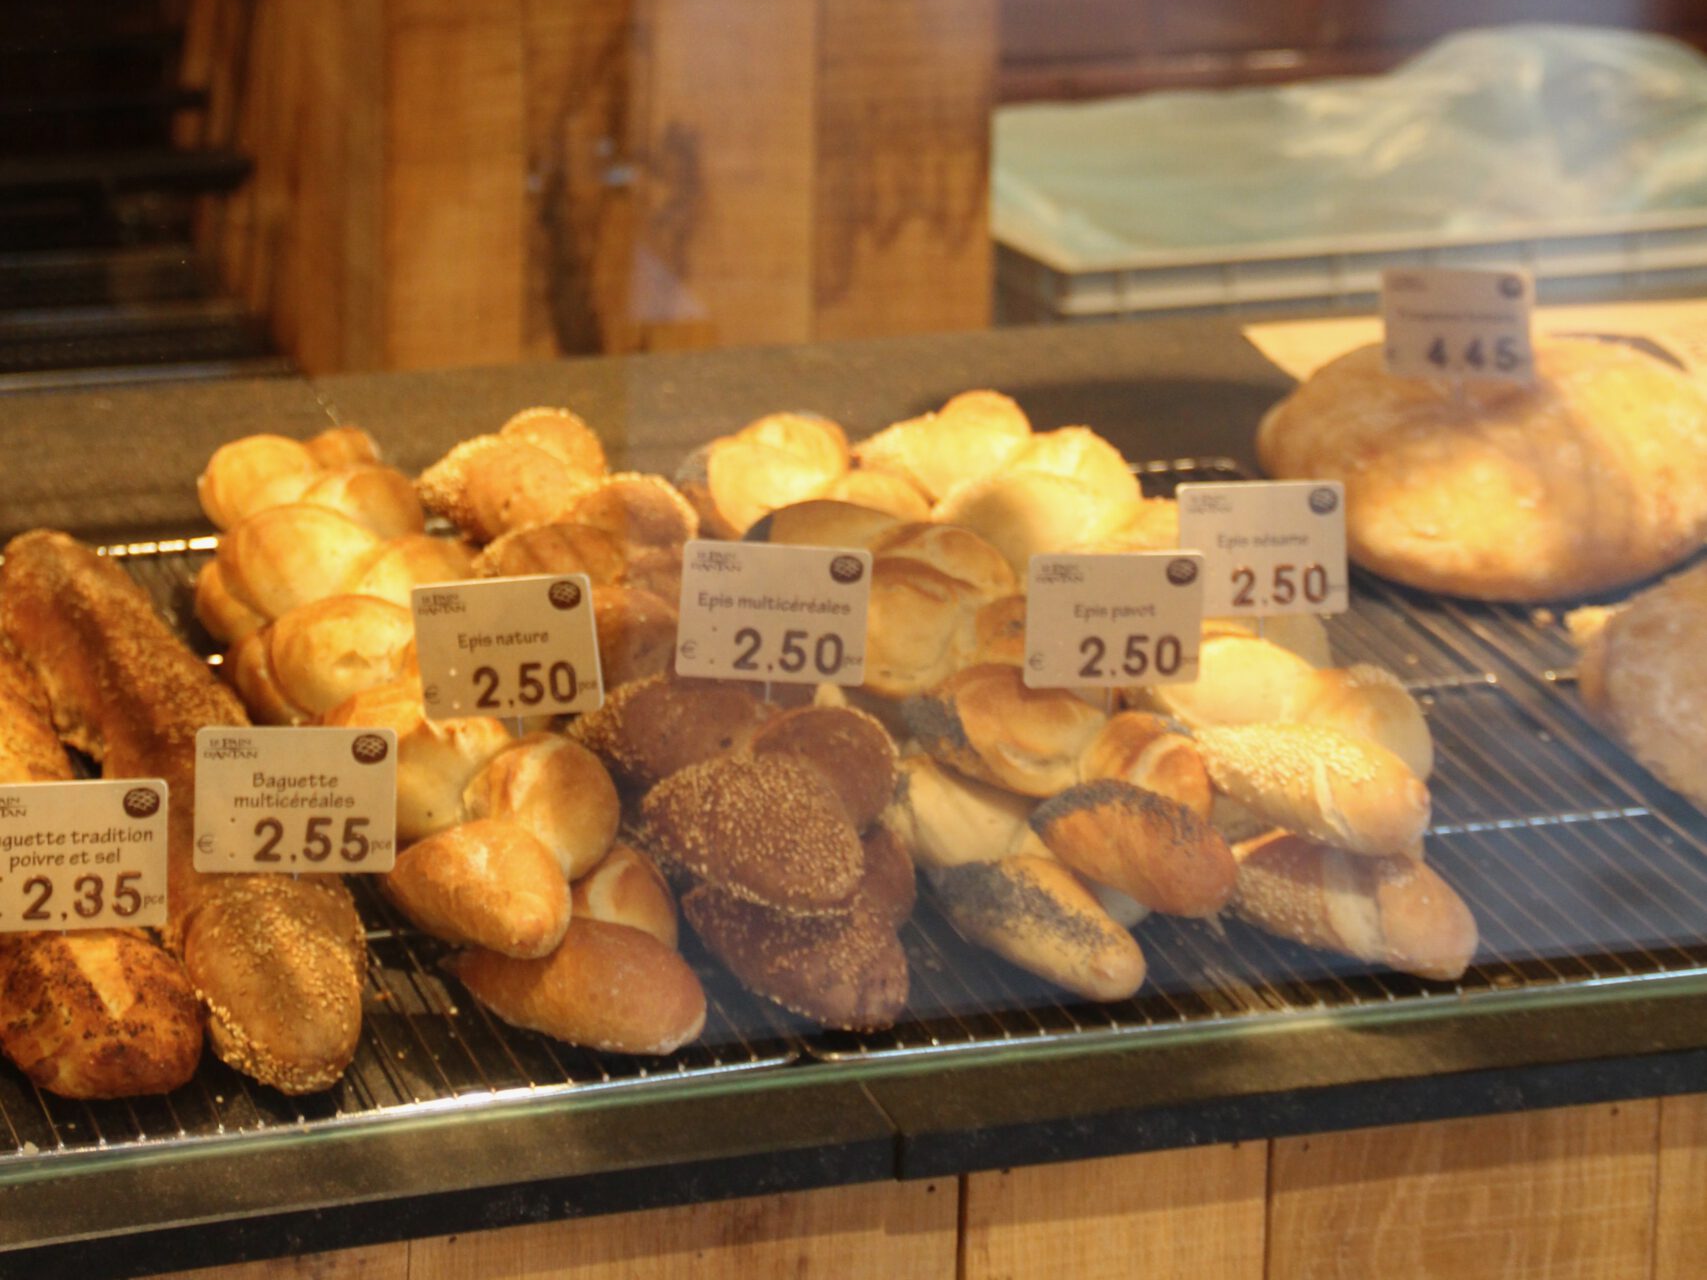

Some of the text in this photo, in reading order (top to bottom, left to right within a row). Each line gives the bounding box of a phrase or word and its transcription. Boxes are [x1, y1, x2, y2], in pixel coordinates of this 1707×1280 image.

[1231, 563, 1328, 608] 2.50
[698, 592, 852, 615] Epis multicéréales
[1073, 604, 1108, 622] Epis
[457, 631, 549, 653] Epis nature
[732, 627, 845, 676] 2.50
[1078, 634, 1183, 678] 2.50
[472, 661, 578, 709] 2.50
[252, 772, 339, 792] Baguette
[234, 792, 355, 809] multicéréales
[0, 827, 153, 851] guette tradition
[253, 816, 370, 863] 2.55
[370, 841, 392, 855] pce
[9, 847, 121, 873] poivre et sel
[22, 871, 165, 921] 2.35 pce
